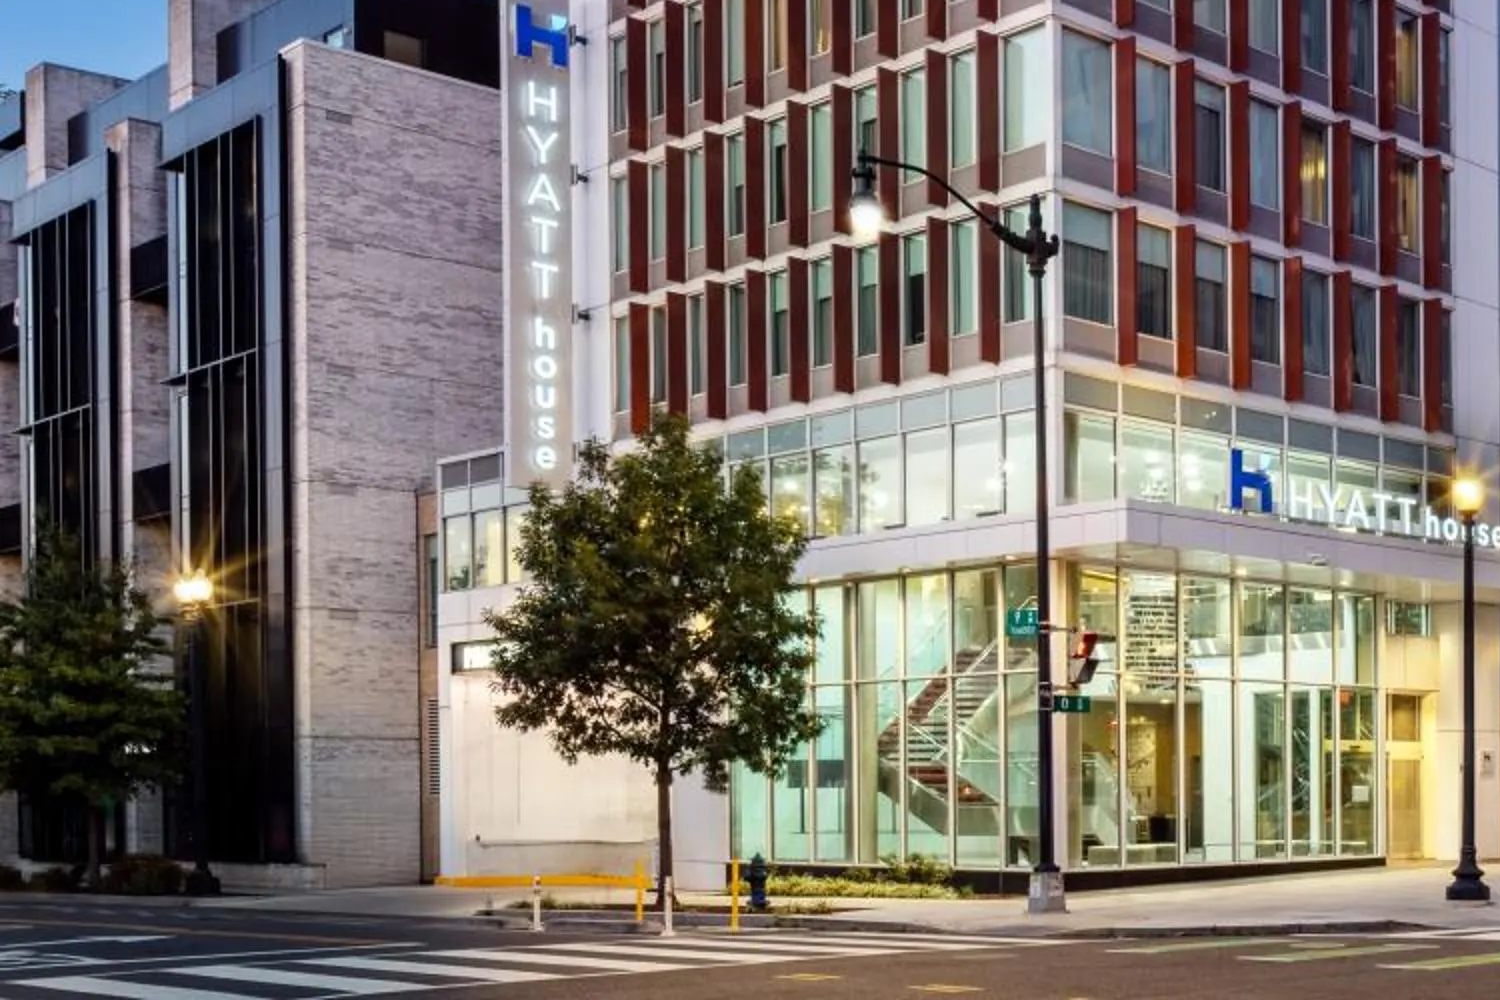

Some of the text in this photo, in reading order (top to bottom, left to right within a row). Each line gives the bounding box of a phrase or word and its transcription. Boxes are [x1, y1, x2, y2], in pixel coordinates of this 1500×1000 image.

[527, 80, 560, 470] HYATT house
[1289, 479, 1416, 535] HYATT
